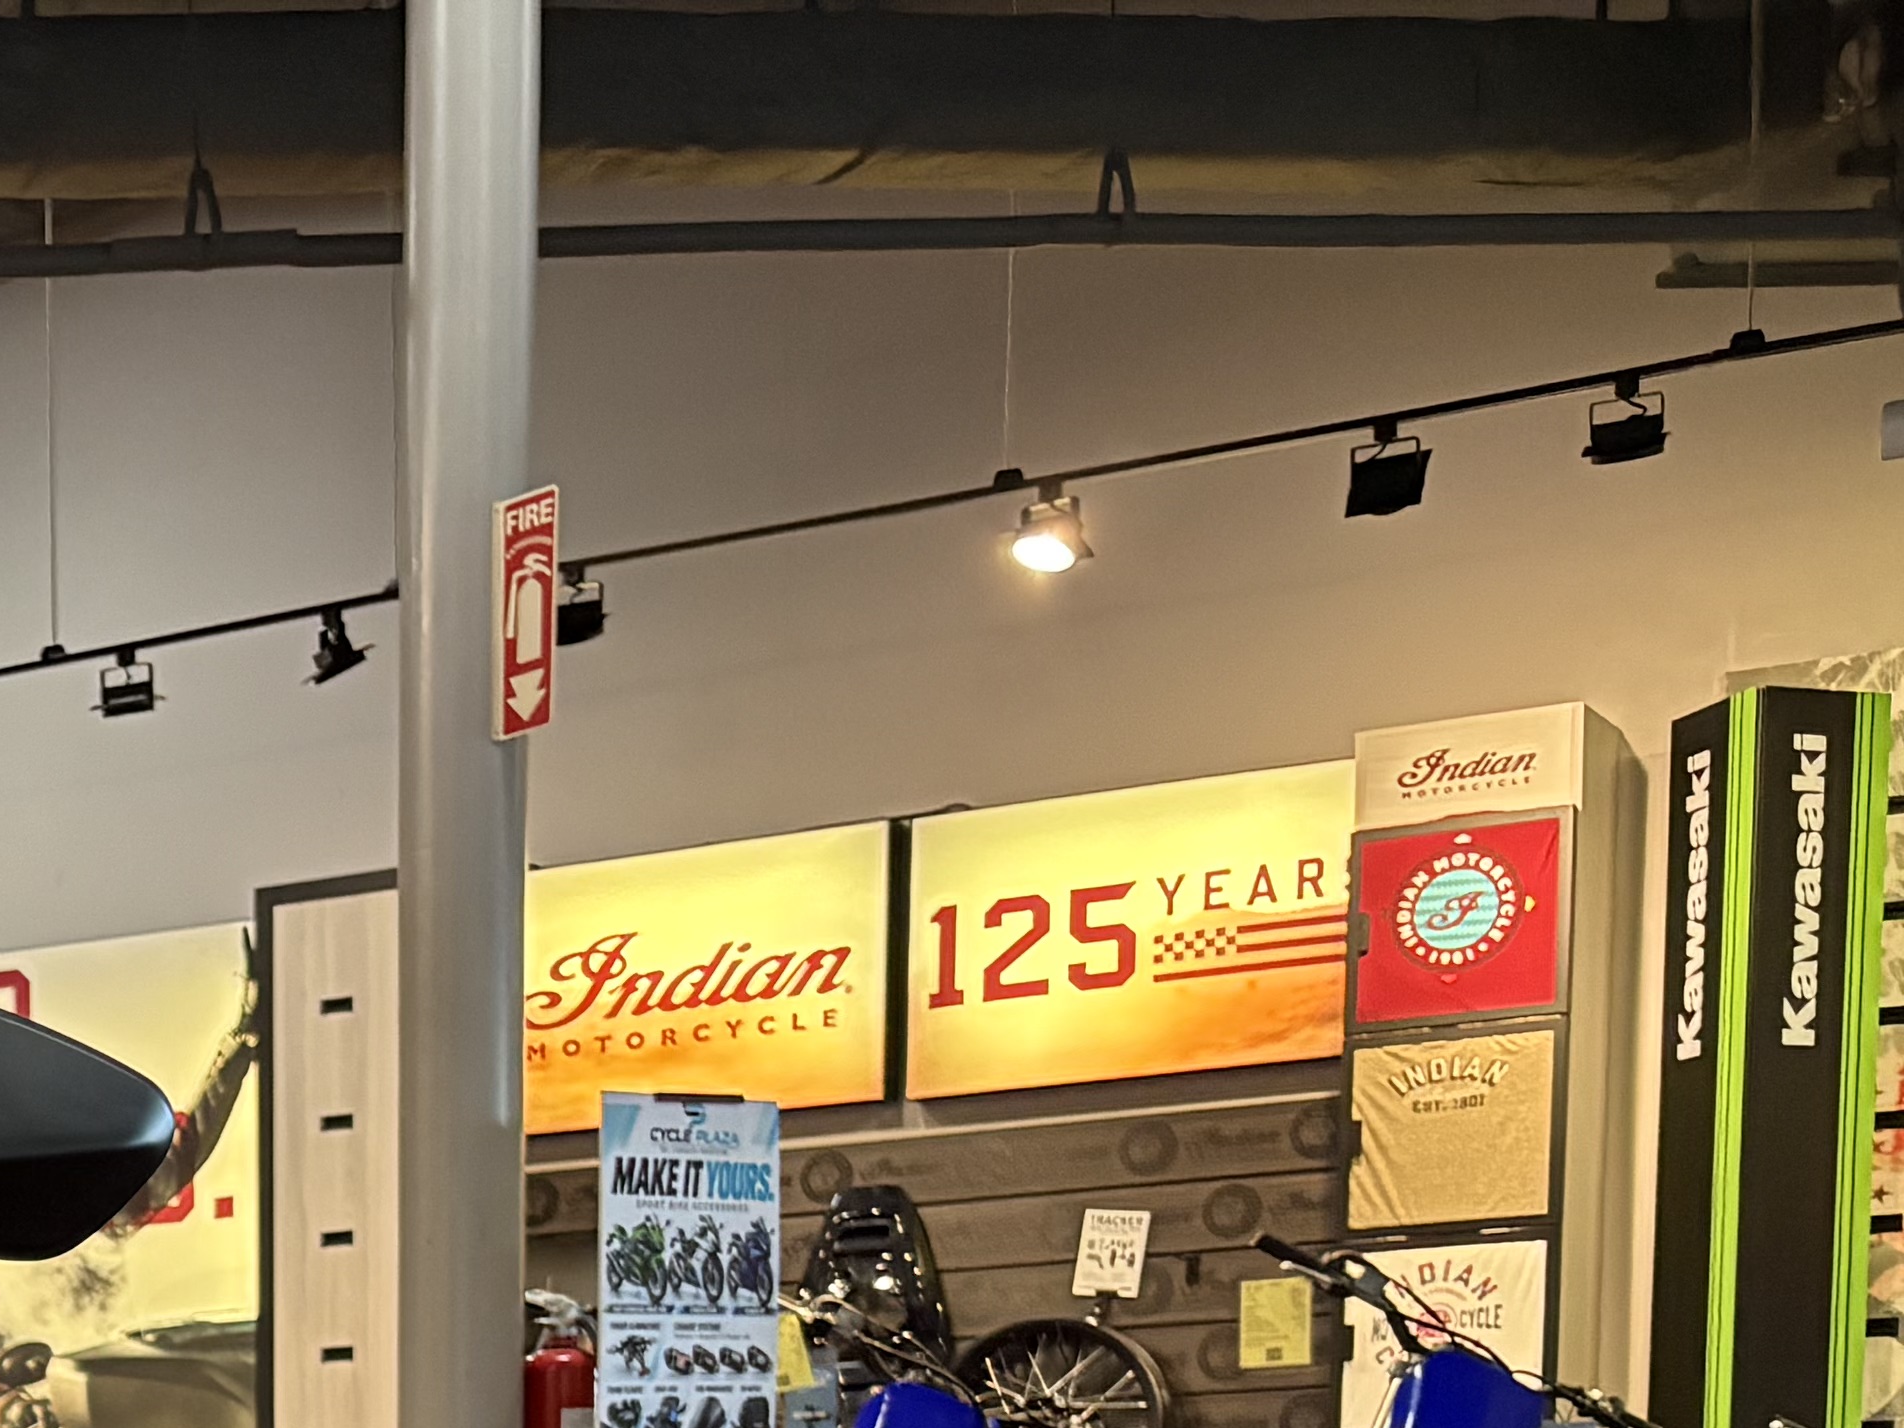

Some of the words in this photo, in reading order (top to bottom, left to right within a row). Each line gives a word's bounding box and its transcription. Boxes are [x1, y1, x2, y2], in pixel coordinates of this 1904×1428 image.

[506, 498, 554, 536] FIRE
[1397, 748, 1537, 789] Indian
[1401, 775, 1532, 800] MOTORCYCLE
[1676, 748, 1712, 1061] Kawasaki
[1781, 732, 1827, 1048] Kawasaki
[927, 881, 1137, 1010] 125
[1155, 856, 1350, 916] YEAR
[525, 931, 852, 1031] Indian
[526, 1008, 839, 1062] MOTORCYCLE
[1388, 1055, 1510, 1097] INDIAN
[611, 1156, 680, 1197] MAKE
[682, 1159, 704, 1199] IT
[706, 1160, 776, 1202] YOURS.
[1393, 1259, 1498, 1301] NDIAN
